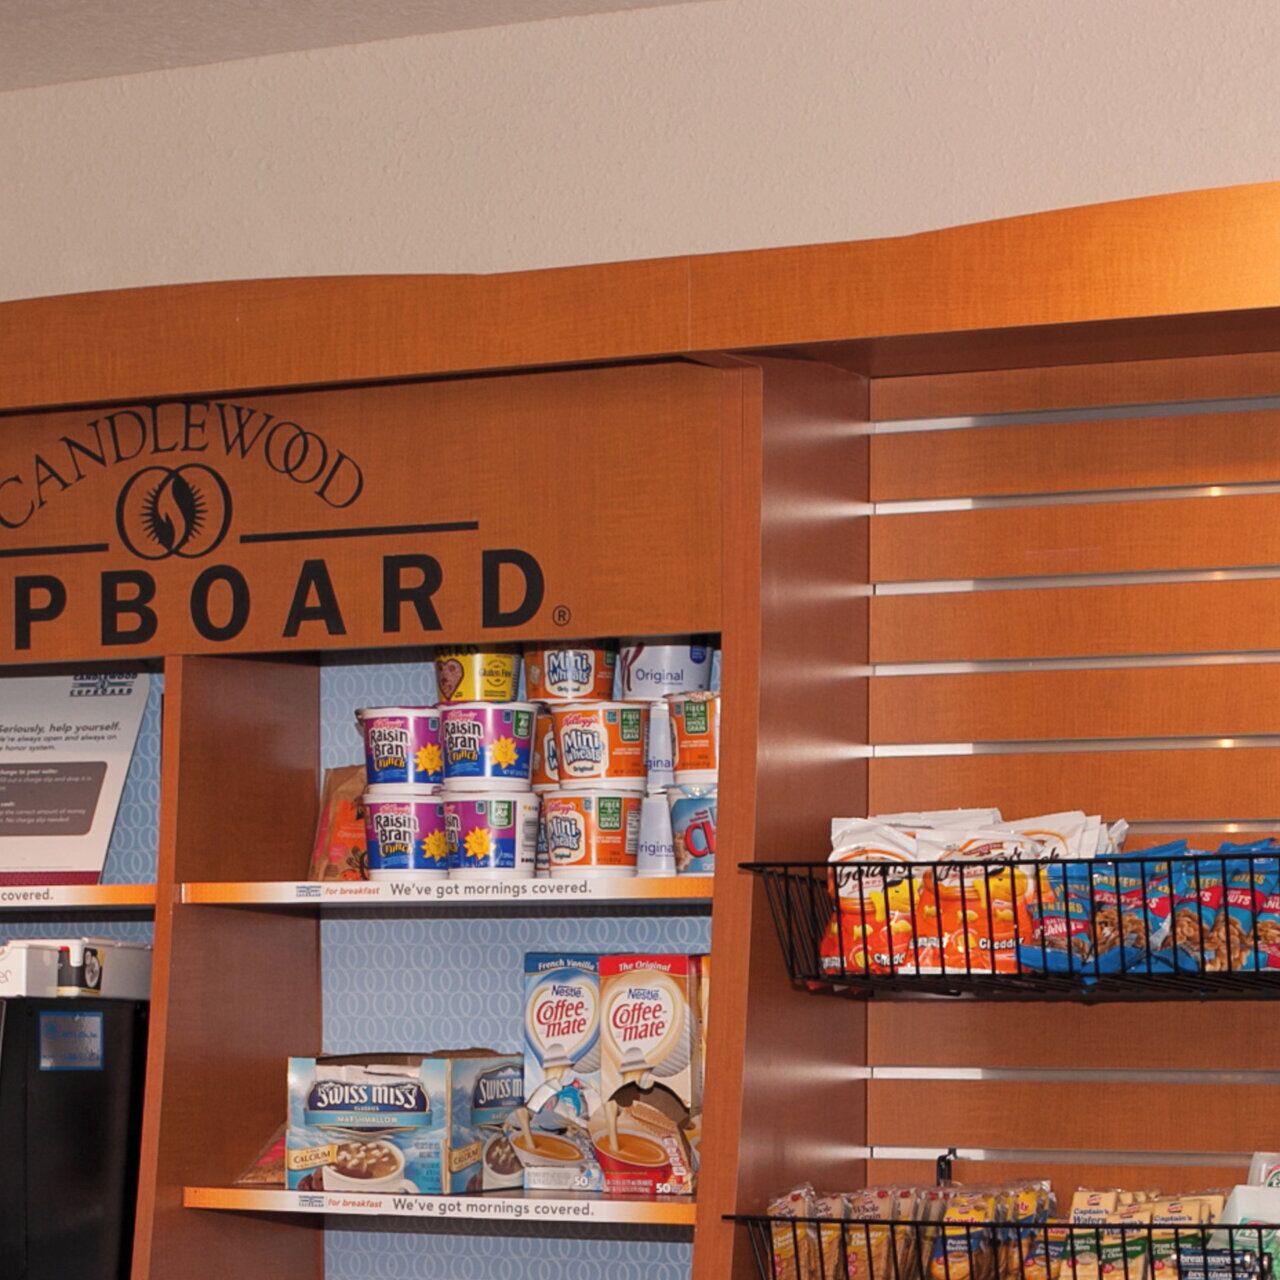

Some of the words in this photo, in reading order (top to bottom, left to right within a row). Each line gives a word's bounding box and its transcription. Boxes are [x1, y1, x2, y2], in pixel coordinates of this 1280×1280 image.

[635, 668, 684, 682] Original
[70, 688, 133, 697] CUPBOARD
[49, 723, 72, 735] help
[74, 721, 120, 734] yourself.
[444, 722, 483, 736] Raisin
[370, 729, 409, 743] Raisin
[564, 729, 600, 749] Mini
[448, 736, 477, 751] Bran
[374, 744, 405, 758] Bran
[375, 814, 418, 832] Raisin
[380, 828, 412, 844] Bran
[1, 888, 54, 902] covered.
[391, 883, 432, 896] We've
[436, 884, 459, 899] got
[464, 882, 527, 898] mornings
[532, 880, 592, 895] covered.
[538, 959, 564, 971] French
[567, 959, 595, 970] Vanilla
[619, 962, 633, 971] The
[635, 960, 671, 972] Original
[546, 1017, 587, 1038] mate
[622, 1021, 665, 1042] mate
[328, 1198, 341, 1208] for
[342, 1198, 382, 1209] breakfast
[393, 1198, 434, 1212] We've
[438, 1200, 462, 1216] got
[466, 1199, 530, 1217] mornings
[534, 1201, 594, 1217] covered.
